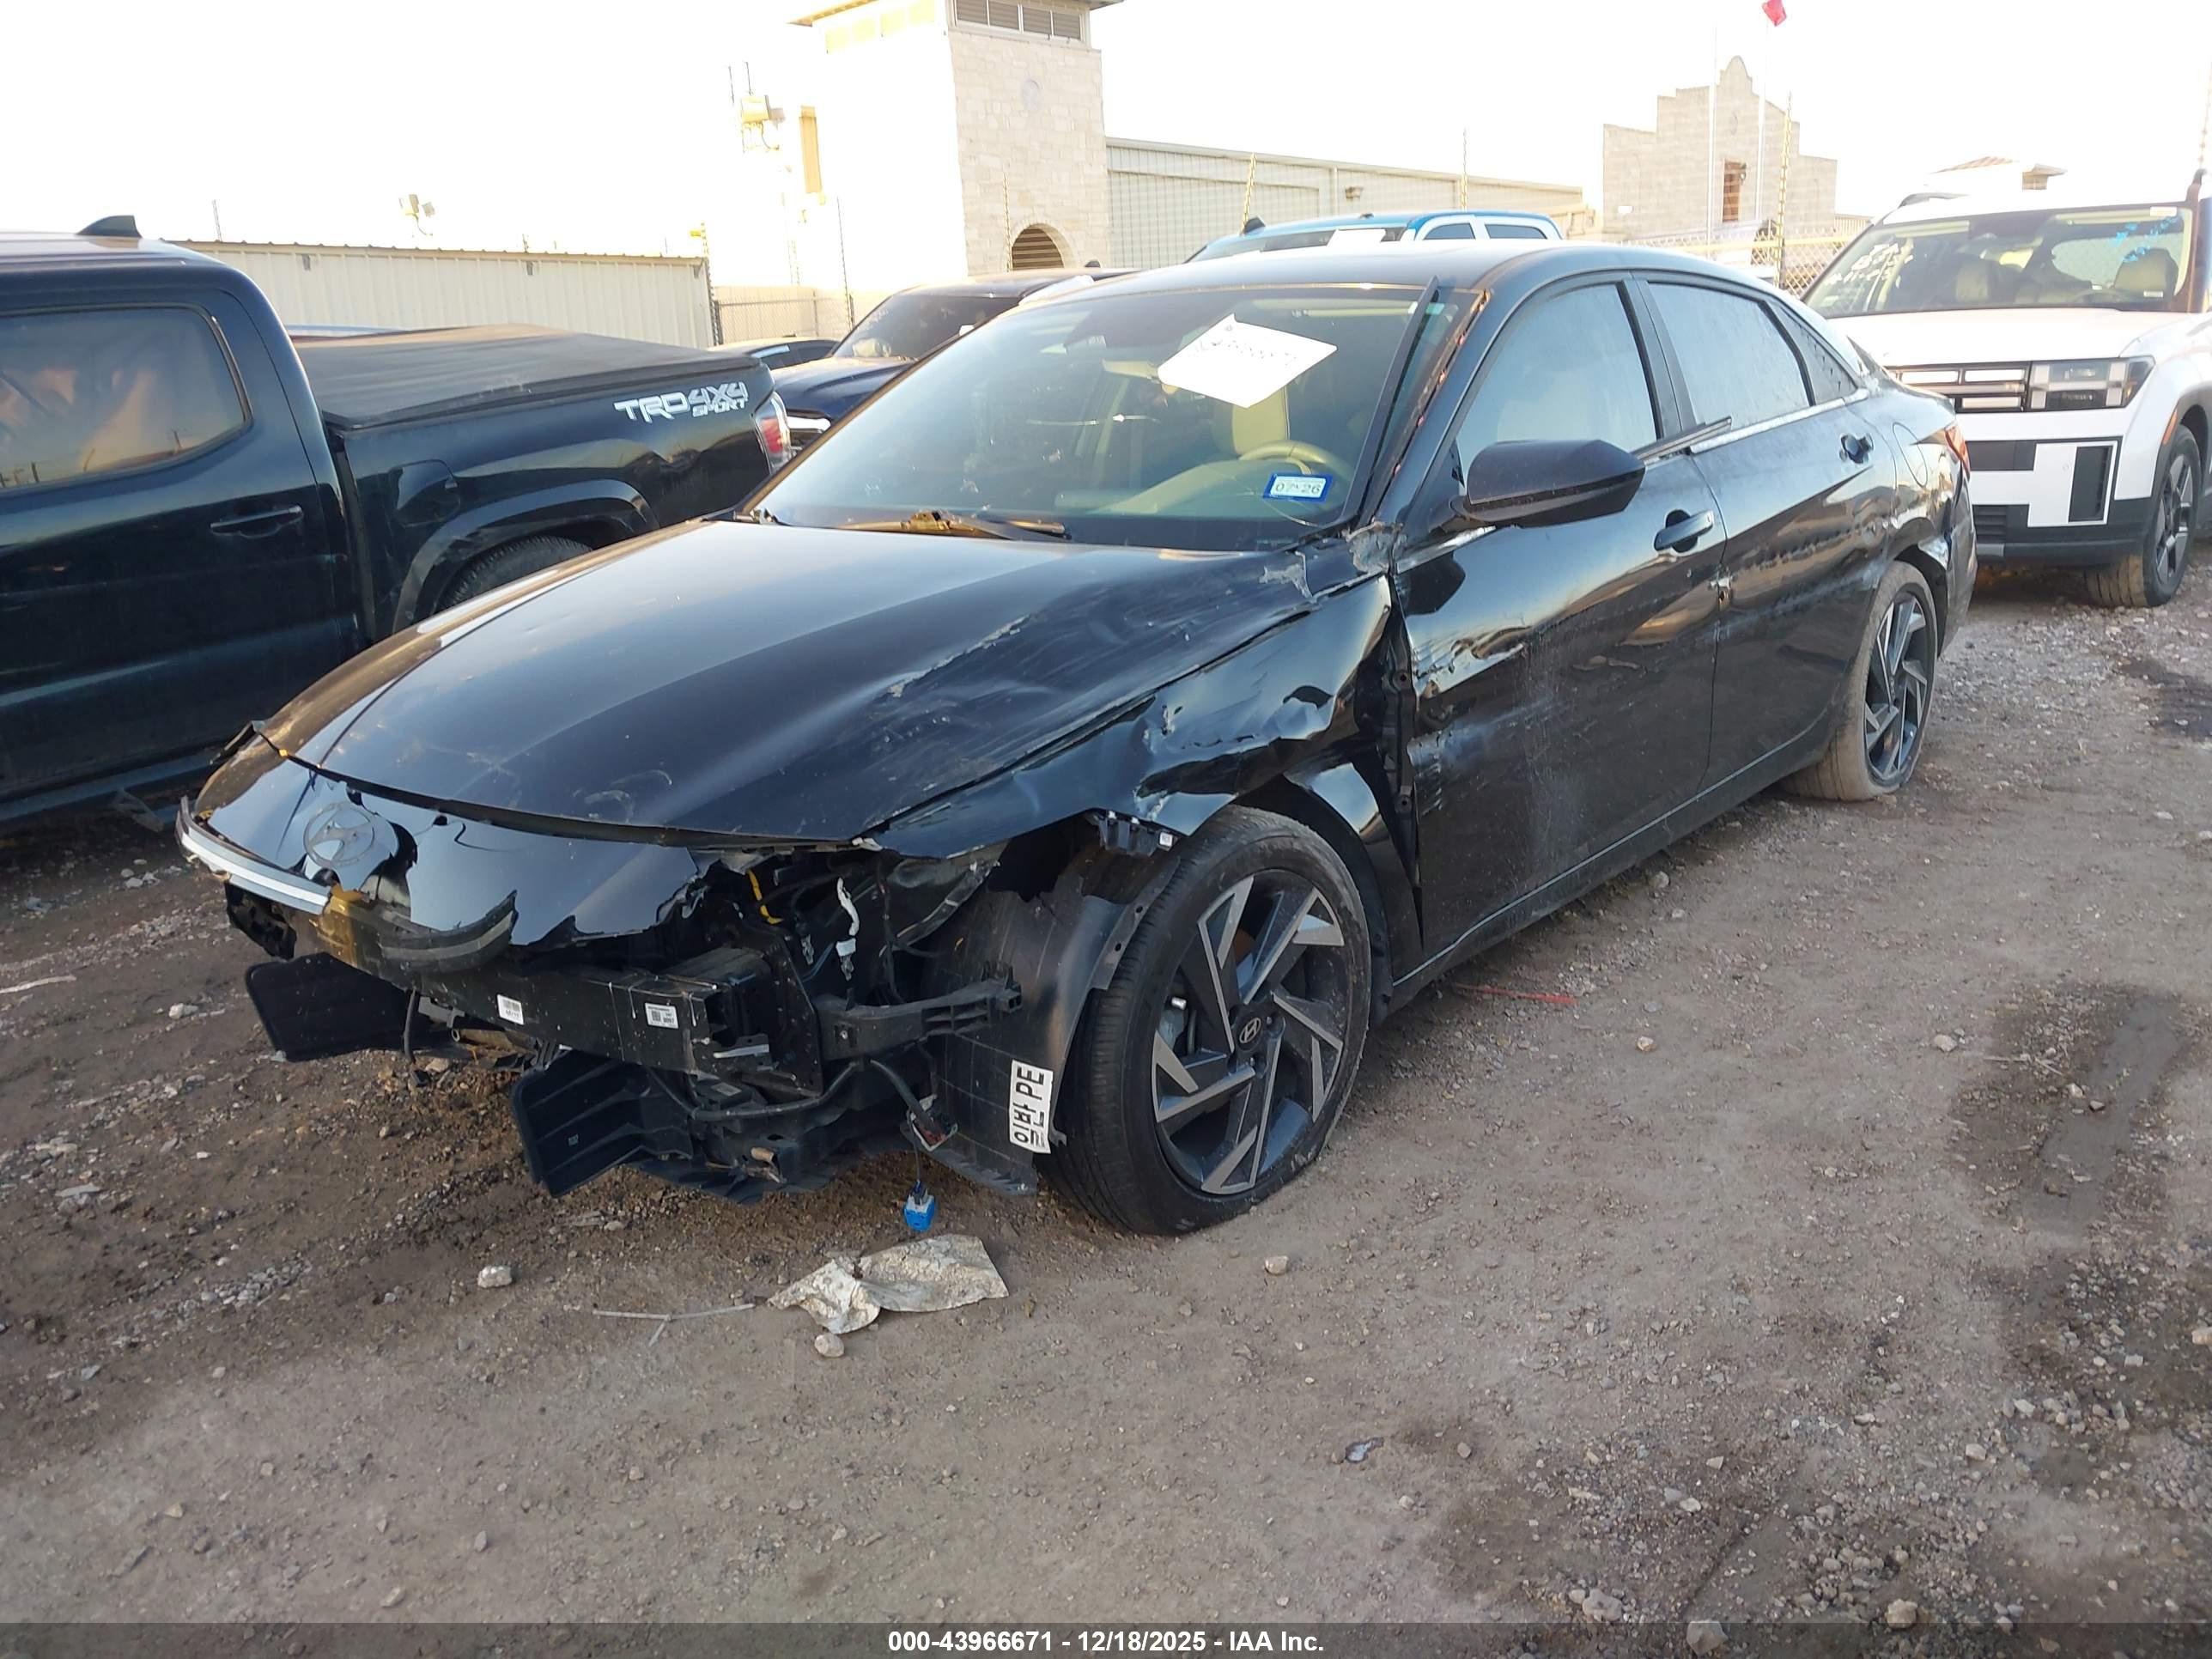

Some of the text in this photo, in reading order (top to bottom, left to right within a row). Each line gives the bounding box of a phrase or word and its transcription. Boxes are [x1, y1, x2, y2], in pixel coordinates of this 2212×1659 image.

[613, 392, 690, 423] TRD
[692, 398, 746, 417] SPORT
[1016, 1066, 1045, 1100] PE
